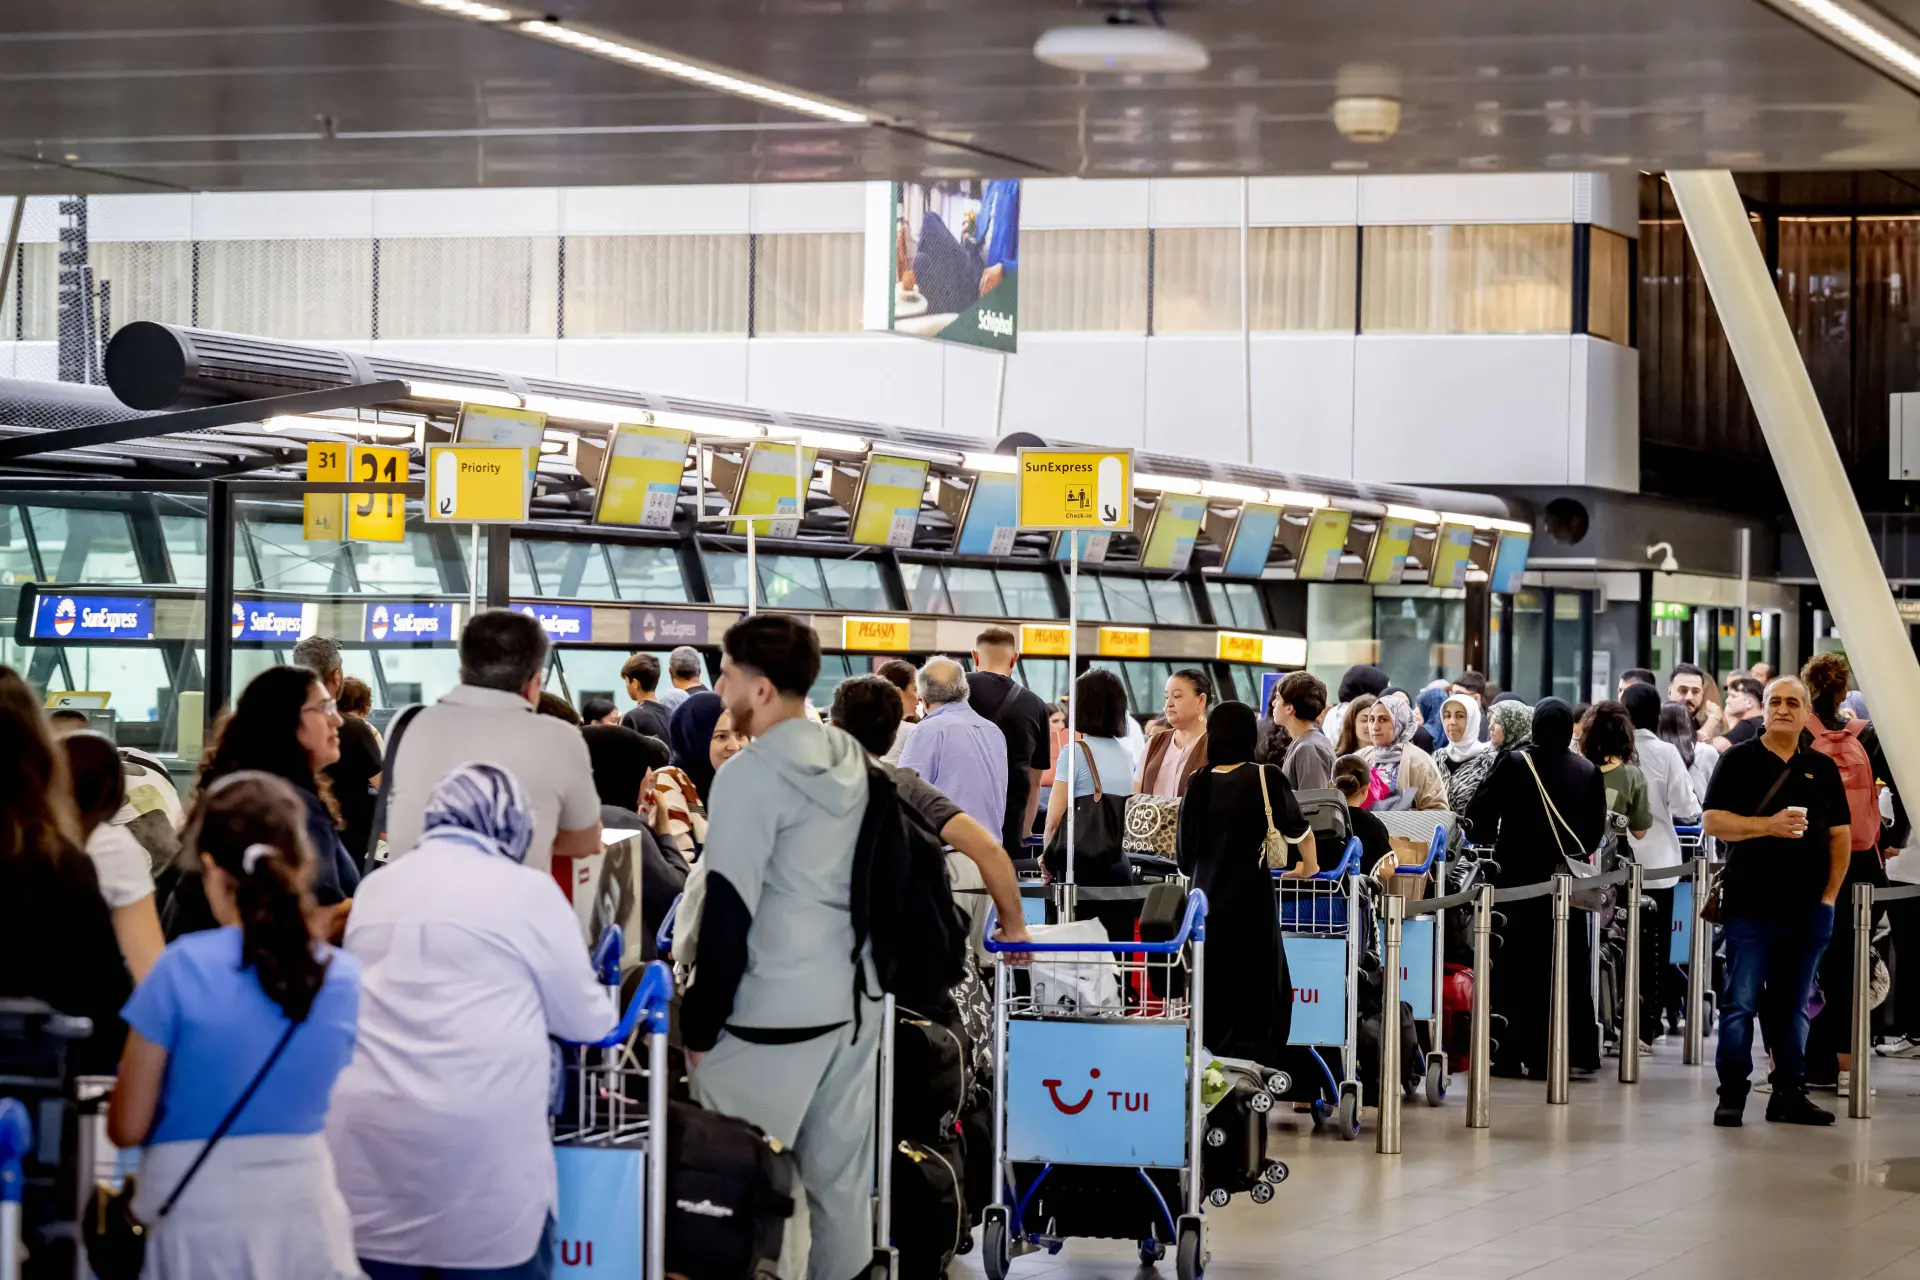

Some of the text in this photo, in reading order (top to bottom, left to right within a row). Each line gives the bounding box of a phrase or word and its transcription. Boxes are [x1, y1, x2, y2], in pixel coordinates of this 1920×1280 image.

[978, 309, 1013, 337] Schiphol
[318, 452, 336, 468] 31
[461, 463, 501, 475] Priority
[1025, 462, 1093, 474] SunExpress
[357, 453, 397, 518] 31
[81, 607, 138, 632] SunExpress
[250, 611, 301, 636] SunExpress
[392, 613, 439, 637] SunExpress
[660, 619, 696, 639] SunExpress
[858, 622, 895, 638] PEGASUS
[1122, 840, 1155, 852] OMODA
[1291, 988, 1318, 1003] TUI
[1107, 1091, 1149, 1112] TUI
[560, 1239, 593, 1266] UI
